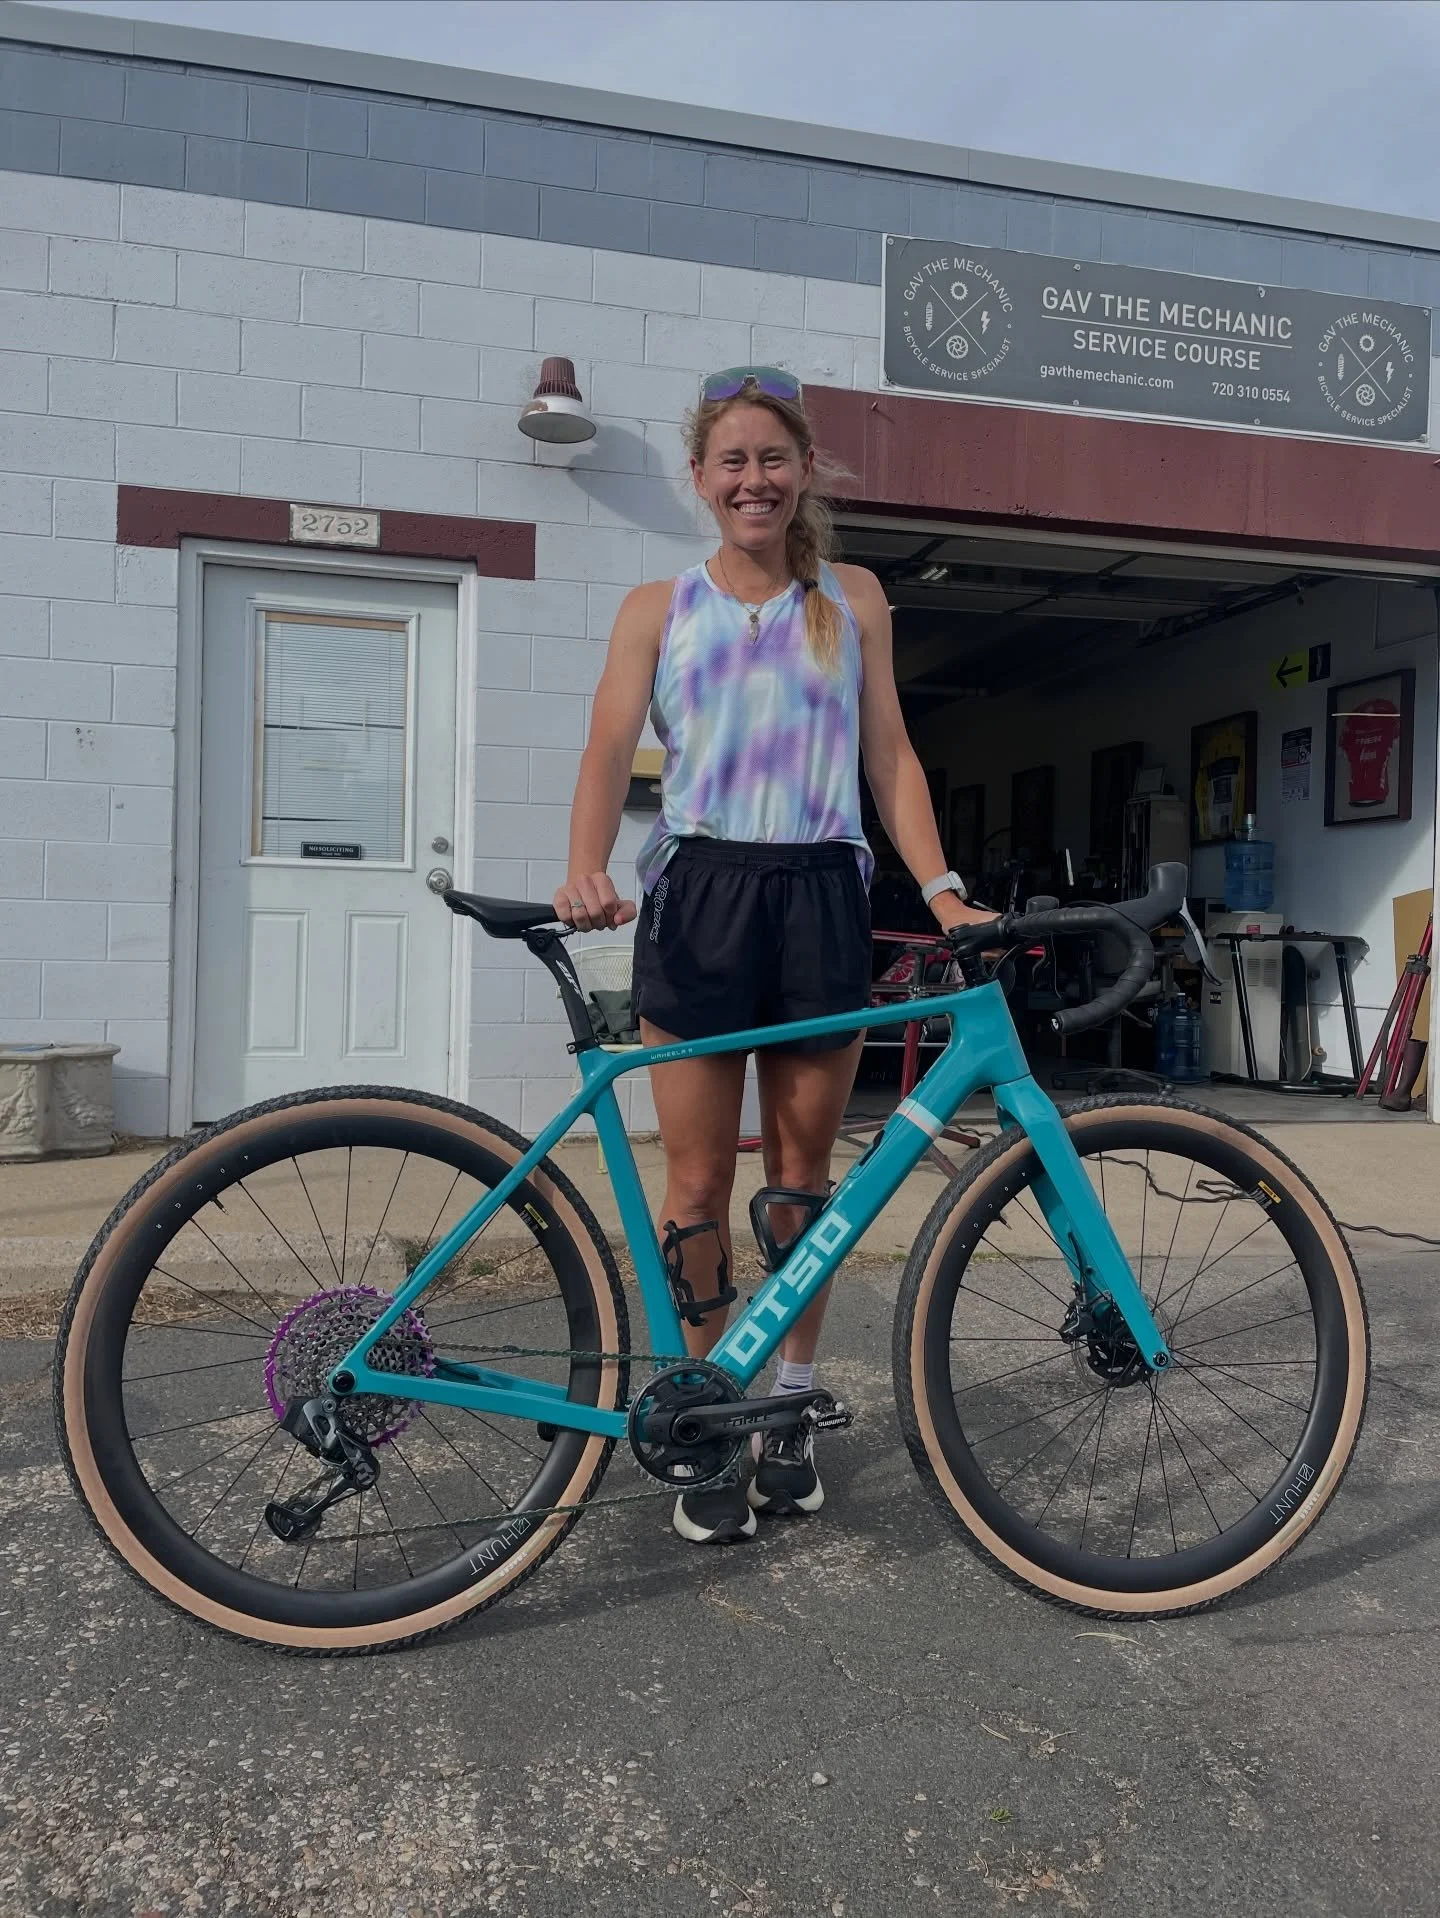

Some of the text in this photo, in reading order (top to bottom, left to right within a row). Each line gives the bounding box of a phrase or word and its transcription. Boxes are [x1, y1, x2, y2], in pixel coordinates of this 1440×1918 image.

[903, 257, 1013, 313] GAV THE MECHANIC
[1042, 286, 1293, 339] GAV THE MECHANIC
[903, 325, 1012, 381] BICYCLE SERVICE SPECIALIST
[1073, 329, 1261, 371] SERVICE COURSE
[1318, 312, 1414, 363] GAV THE MECHANIC
[1040, 363, 1174, 390] gavthemechanic.com
[1212, 381, 1291, 404] 720 310 0554
[1317, 375, 1413, 427] BICYCLE SERVICE SPECIALIST
[302, 513, 369, 537] 2752
[724, 1210, 853, 1368] OTSO
[817, 1417, 847, 1427] SHIMANO
[1269, 1476, 1307, 1525] HUNT
[469, 1527, 519, 1576] HUNT
